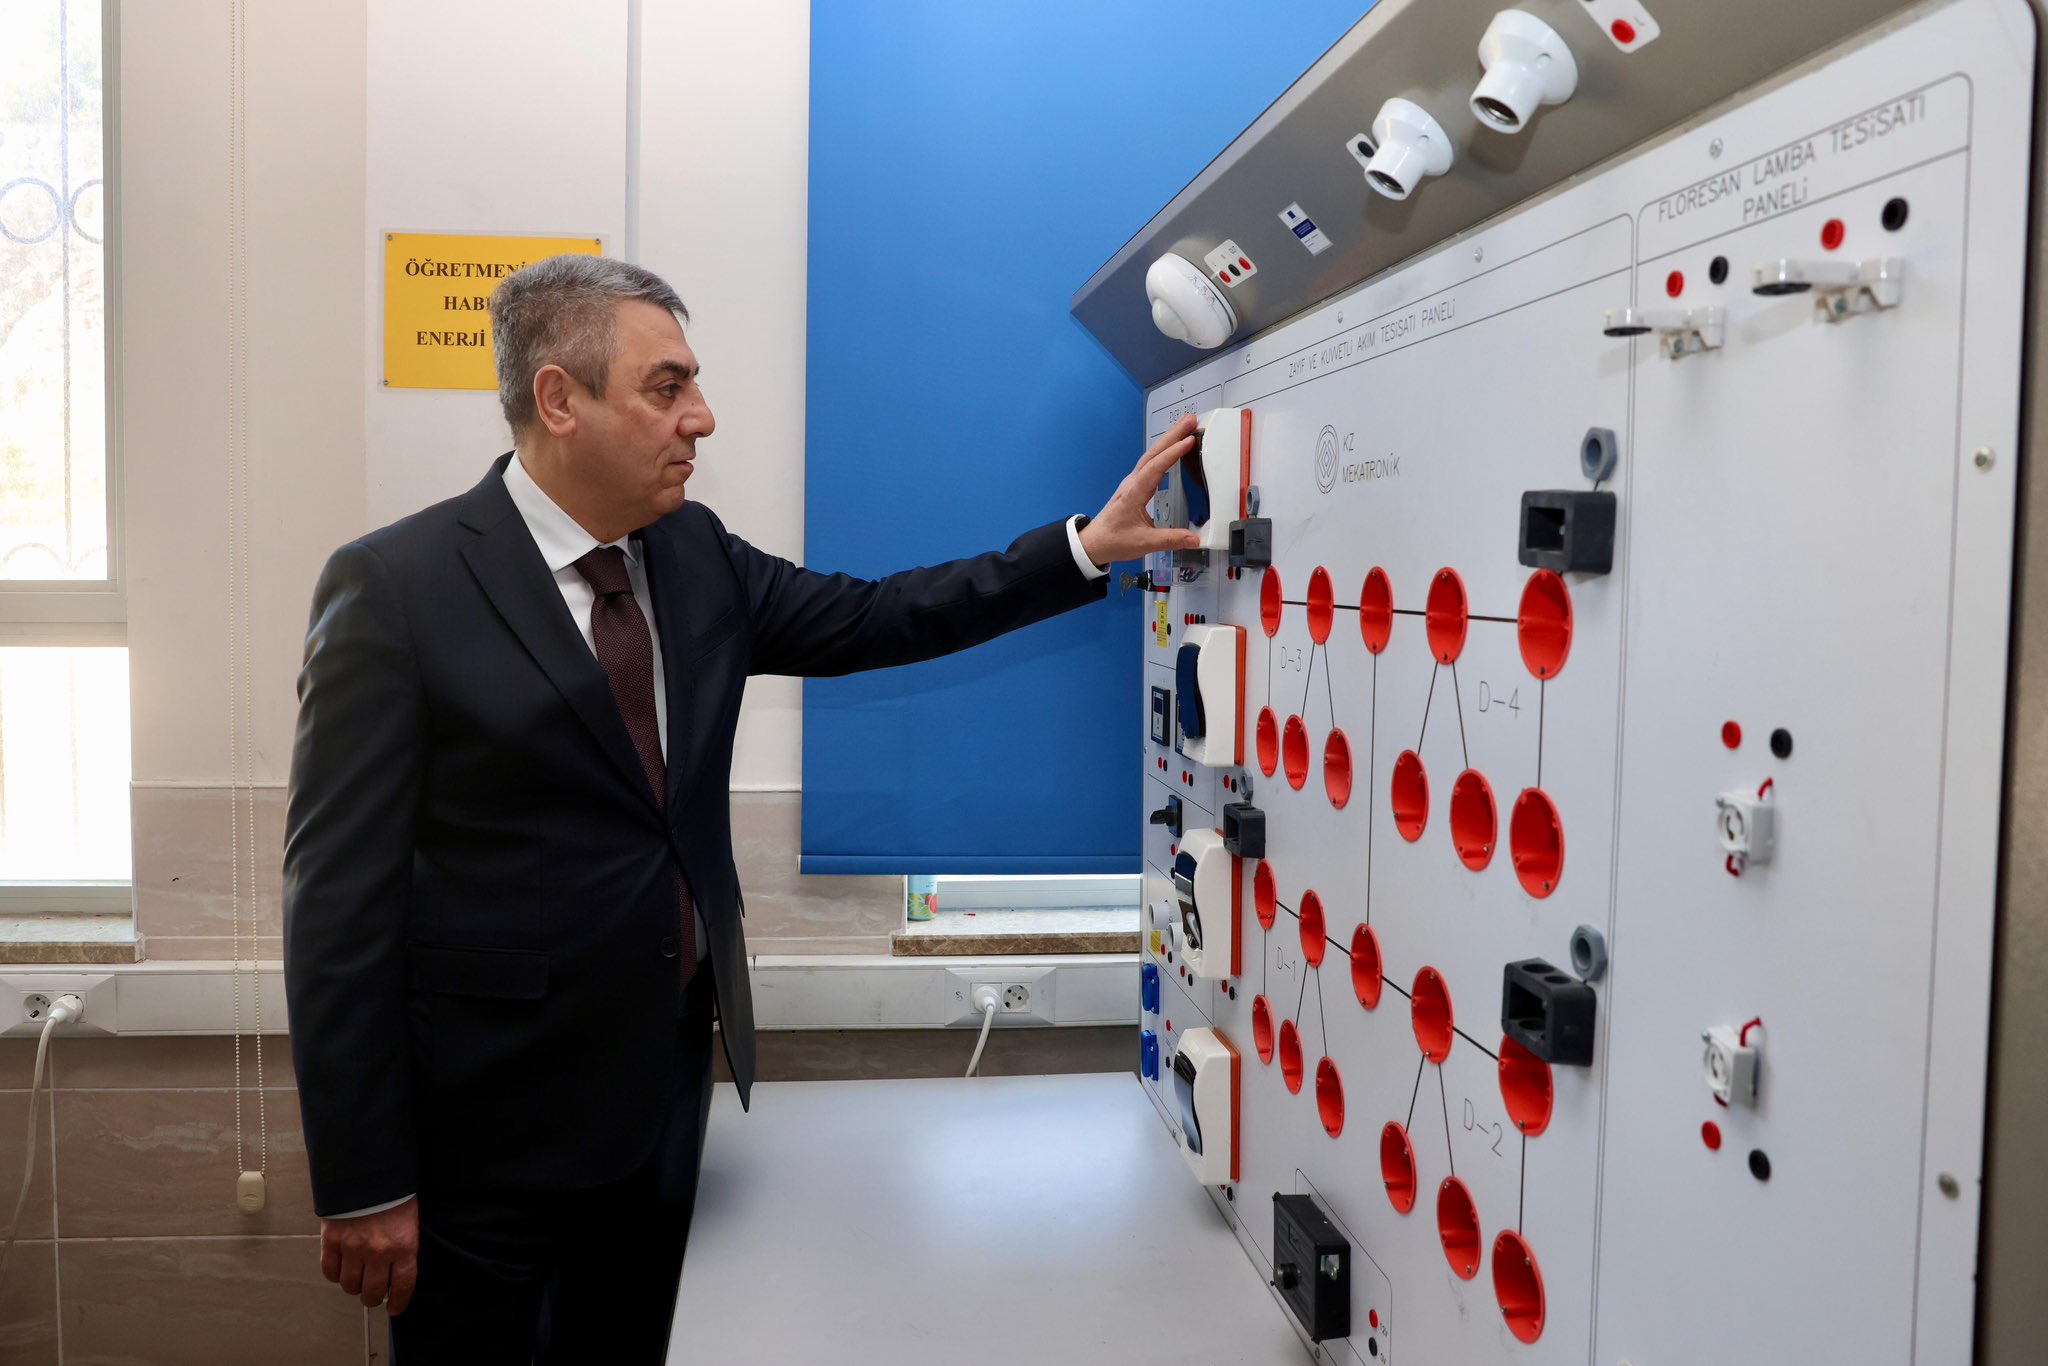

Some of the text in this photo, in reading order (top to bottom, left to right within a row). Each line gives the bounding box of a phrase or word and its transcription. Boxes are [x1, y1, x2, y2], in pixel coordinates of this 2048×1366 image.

[1658, 170, 1741, 222] FLORESAN
[1754, 141, 1816, 185] LAMBA
[416, 329, 486, 347] ENERJİ
[1309, 353, 1318, 370] VE
[1356, 331, 1376, 351] AKIM
[1343, 432, 1355, 452] KZ
[1280, 646, 1302, 673] D-3
[1479, 680, 1521, 720] D-4
[1463, 1097, 1503, 1158] D-2
